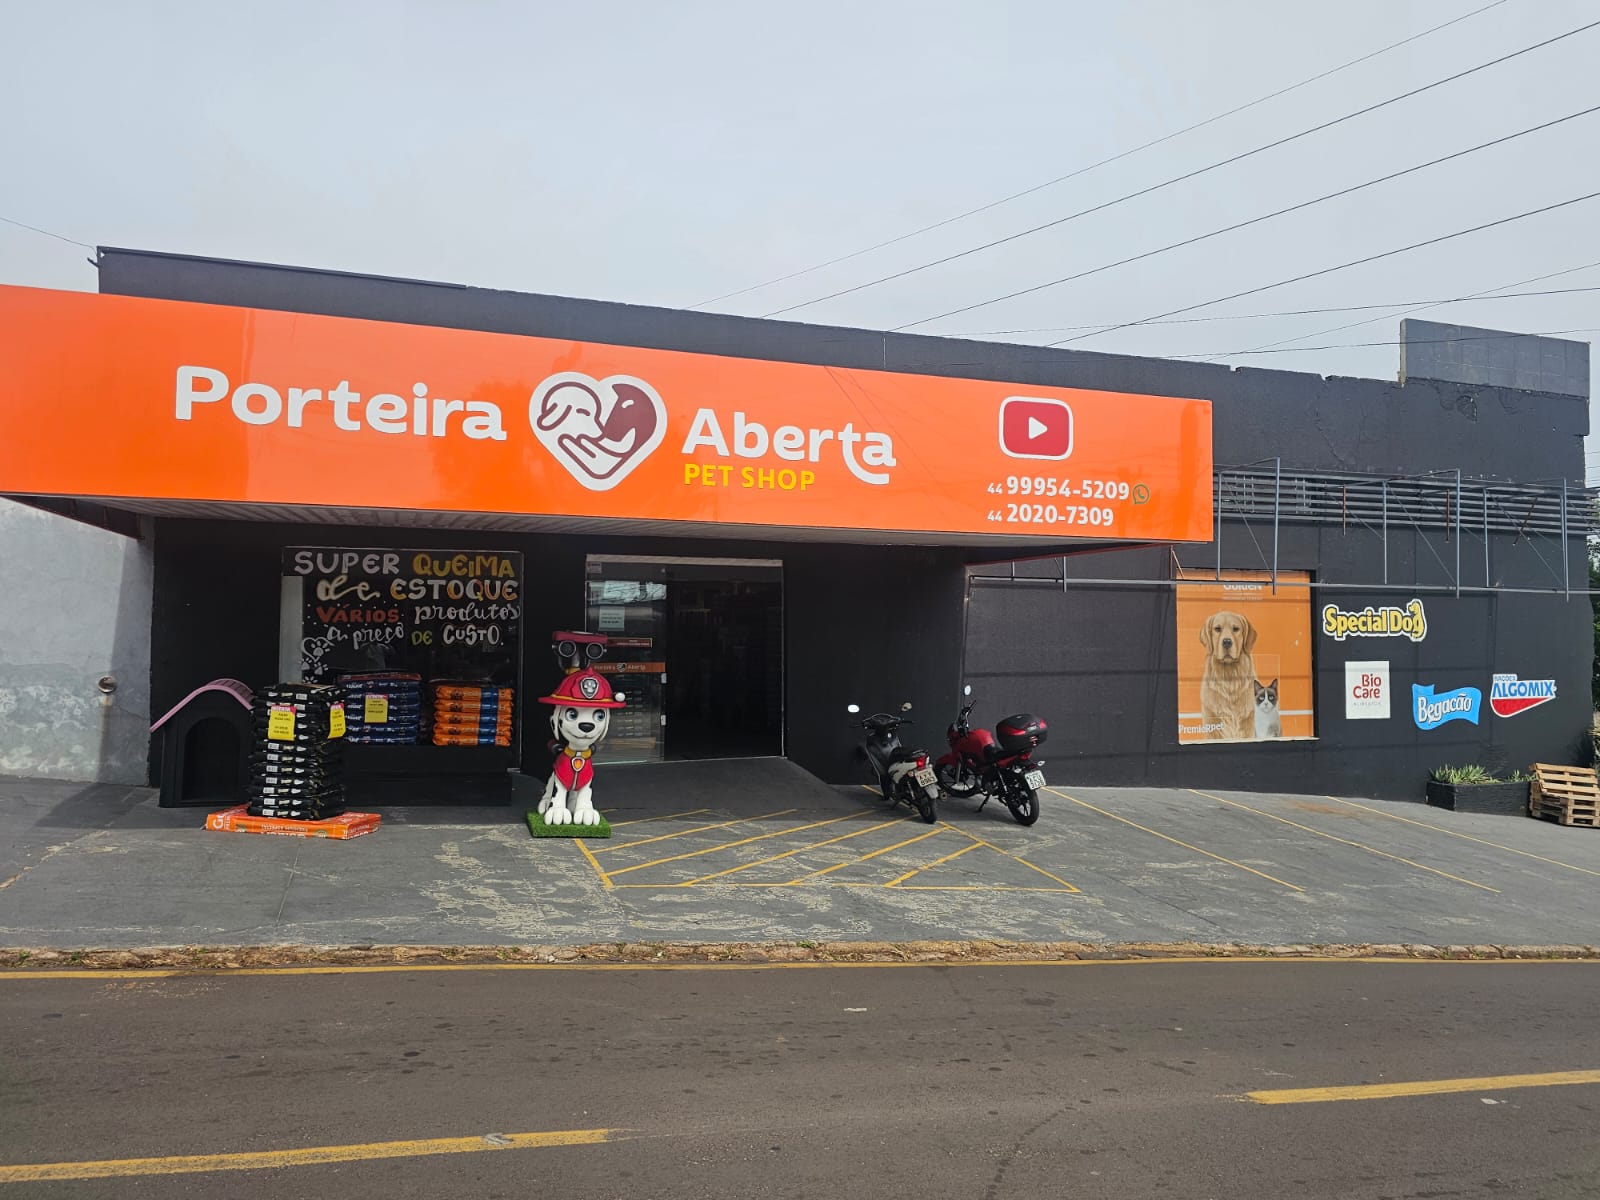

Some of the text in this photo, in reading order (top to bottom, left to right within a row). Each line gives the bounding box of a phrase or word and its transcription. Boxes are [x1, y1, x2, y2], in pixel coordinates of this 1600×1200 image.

[175, 365, 897, 485] Porteira Aberta
[684, 463, 815, 491] PET SHOP
[987, 475, 1130, 500] 44 99954-5209
[987, 504, 1114, 526] 44 2020-7309
[294, 551, 515, 578] SUPER QUEIMA
[316, 574, 519, 602] de ESTOQUE
[316, 601, 522, 625] VÁRIOS produtos
[1324, 600, 1426, 640] Special Dog
[411, 631, 433, 646] DE
[1353, 685, 1381, 699] Care
[1361, 673, 1381, 687] Bio
[1492, 681, 1553, 698] ALGOMIX
